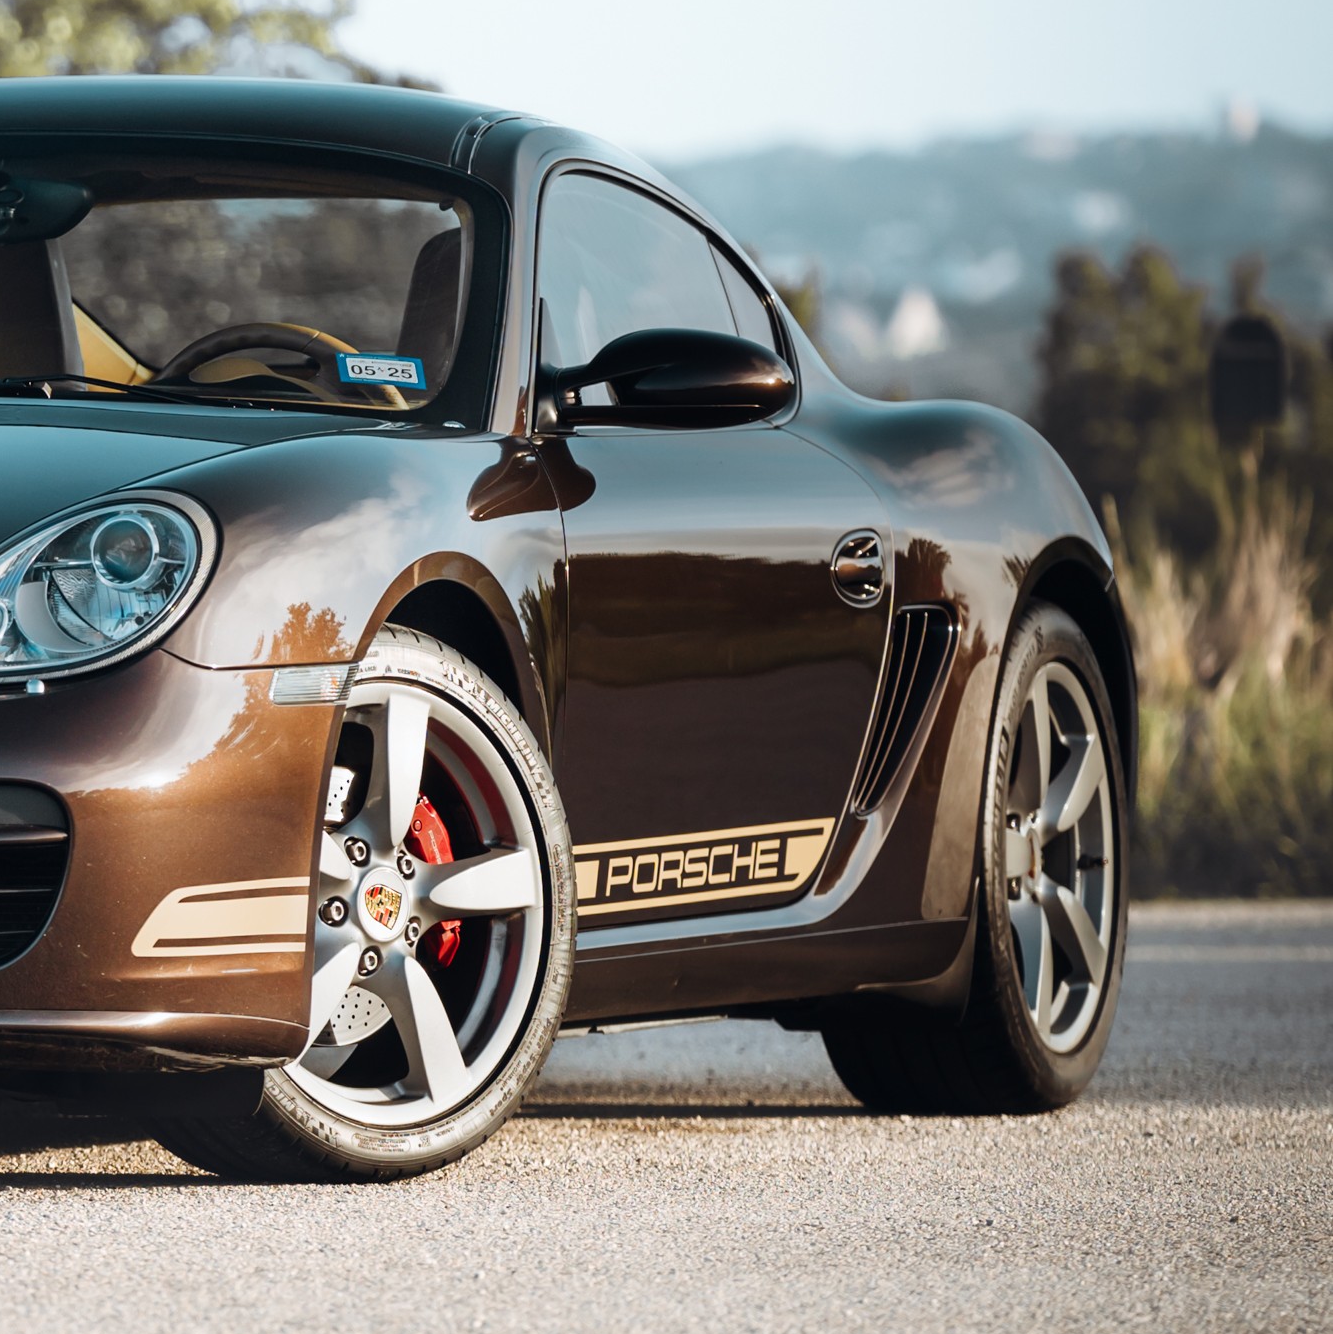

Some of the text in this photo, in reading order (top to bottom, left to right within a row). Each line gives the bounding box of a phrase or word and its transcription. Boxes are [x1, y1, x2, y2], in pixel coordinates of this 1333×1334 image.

[350, 364, 413, 379] 05 25
[486, 697, 537, 767] MICHELIN
[605, 838, 781, 897] PORSCHE
[516, 1053, 538, 1087] Super
[489, 1088, 514, 1117] Sport
